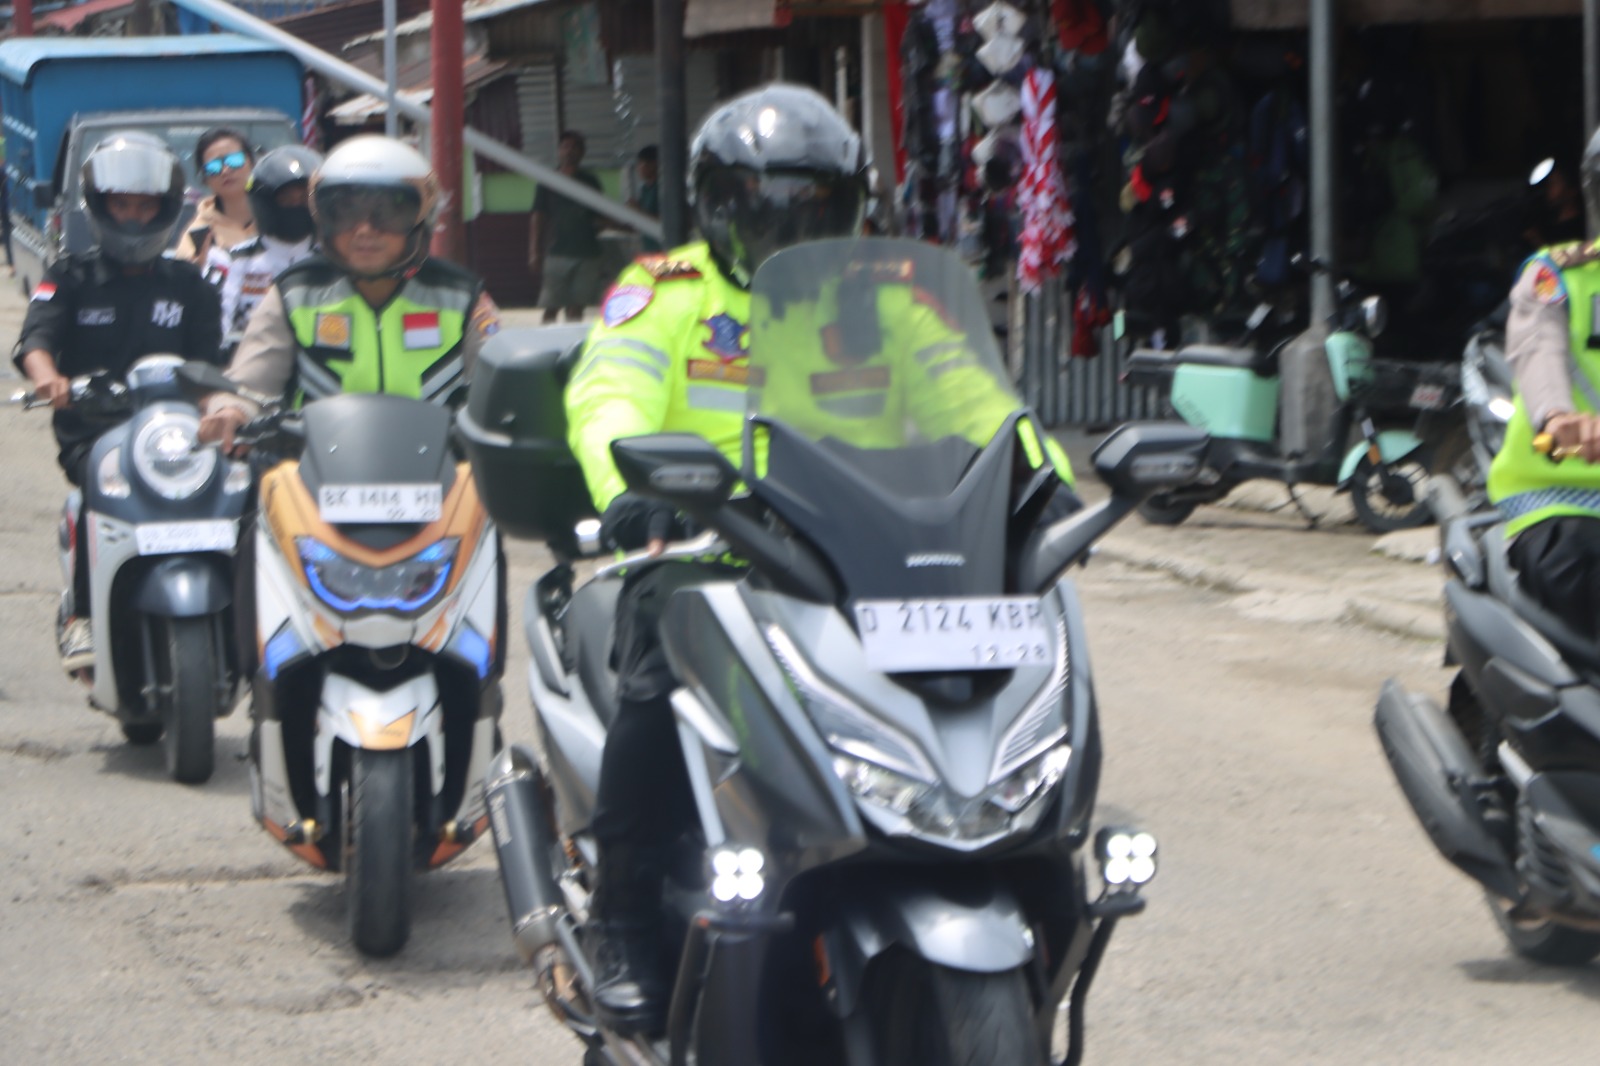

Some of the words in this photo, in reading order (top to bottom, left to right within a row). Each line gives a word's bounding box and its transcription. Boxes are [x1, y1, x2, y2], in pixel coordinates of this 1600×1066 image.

[905, 553, 965, 568] HONDA
[861, 606, 877, 632] D
[899, 602, 973, 632] 2124
